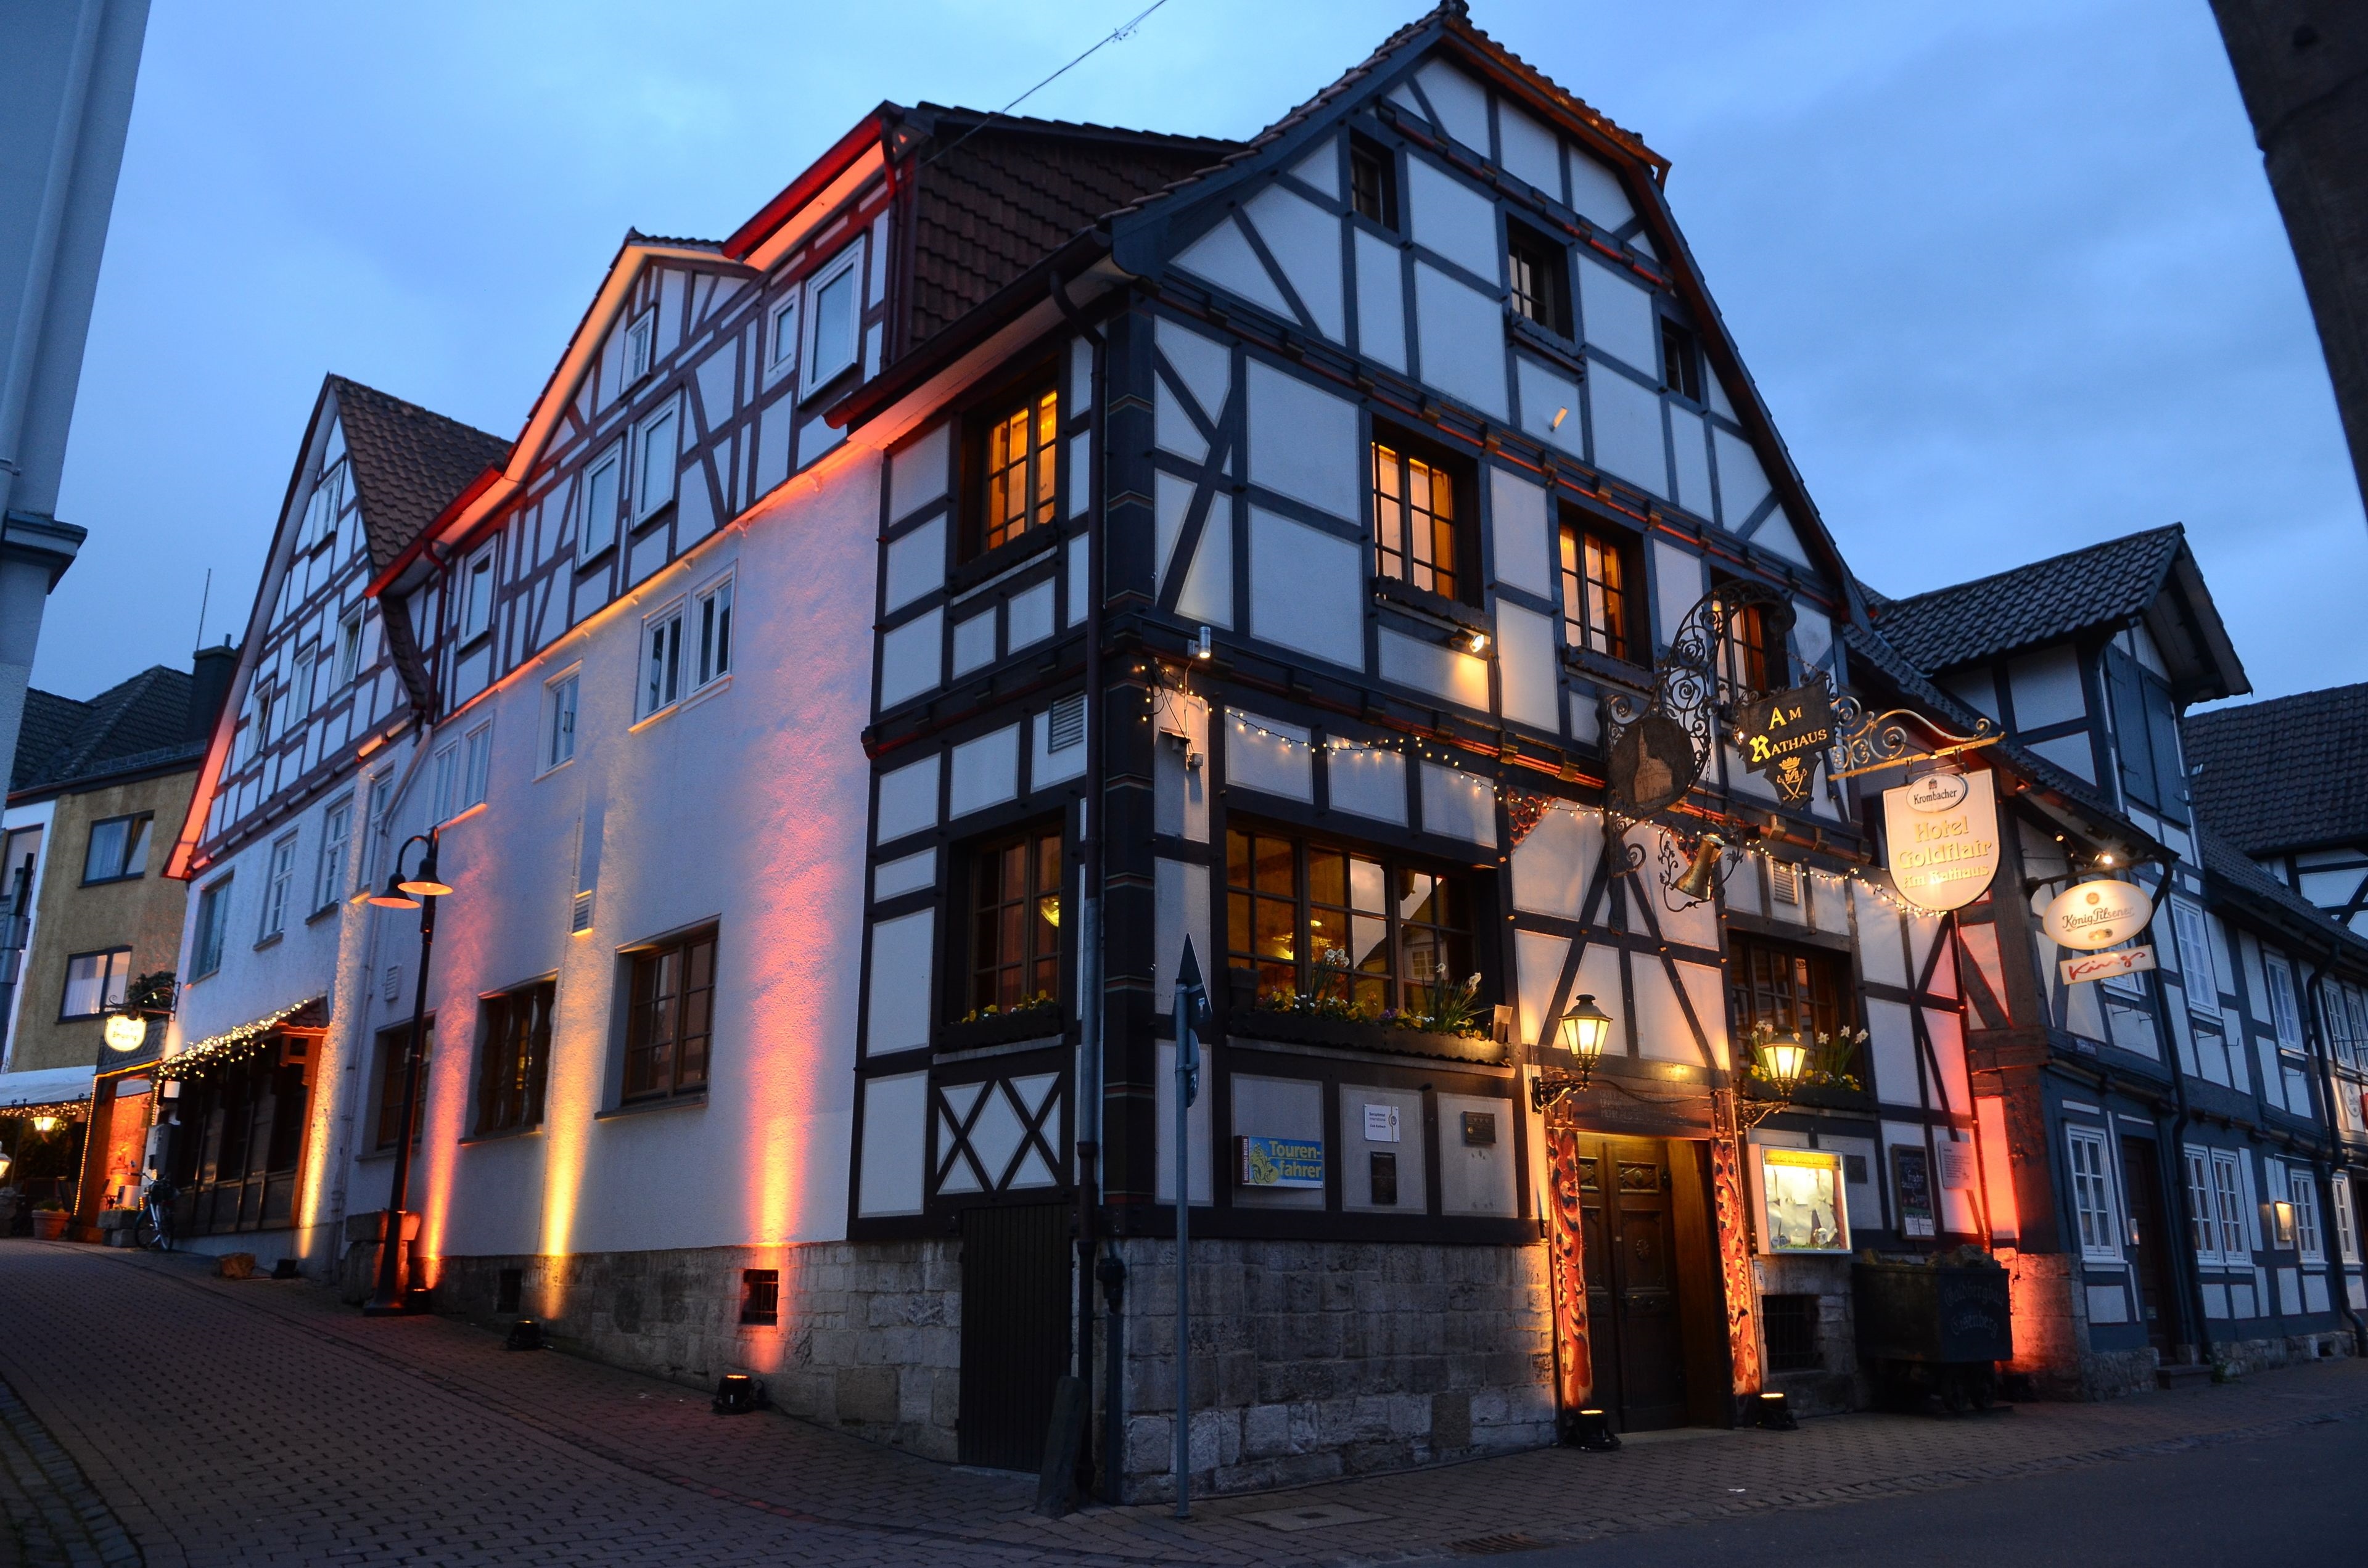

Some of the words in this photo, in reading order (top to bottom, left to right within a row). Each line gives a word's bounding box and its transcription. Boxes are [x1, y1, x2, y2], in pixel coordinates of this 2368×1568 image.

[1914, 789, 1958, 805] Krombacher
[1914, 815, 1969, 844] Hotel
[1898, 840, 1992, 869] Goldflair
[1904, 874, 1927, 889] Am
[1928, 864, 1990, 886] Rathaus
[2062, 914, 2093, 929] König
[2093, 907, 2134, 922] Pilsener
[1268, 1140, 1322, 1159] Touren-
[1280, 1159, 1322, 1178] fahrer
